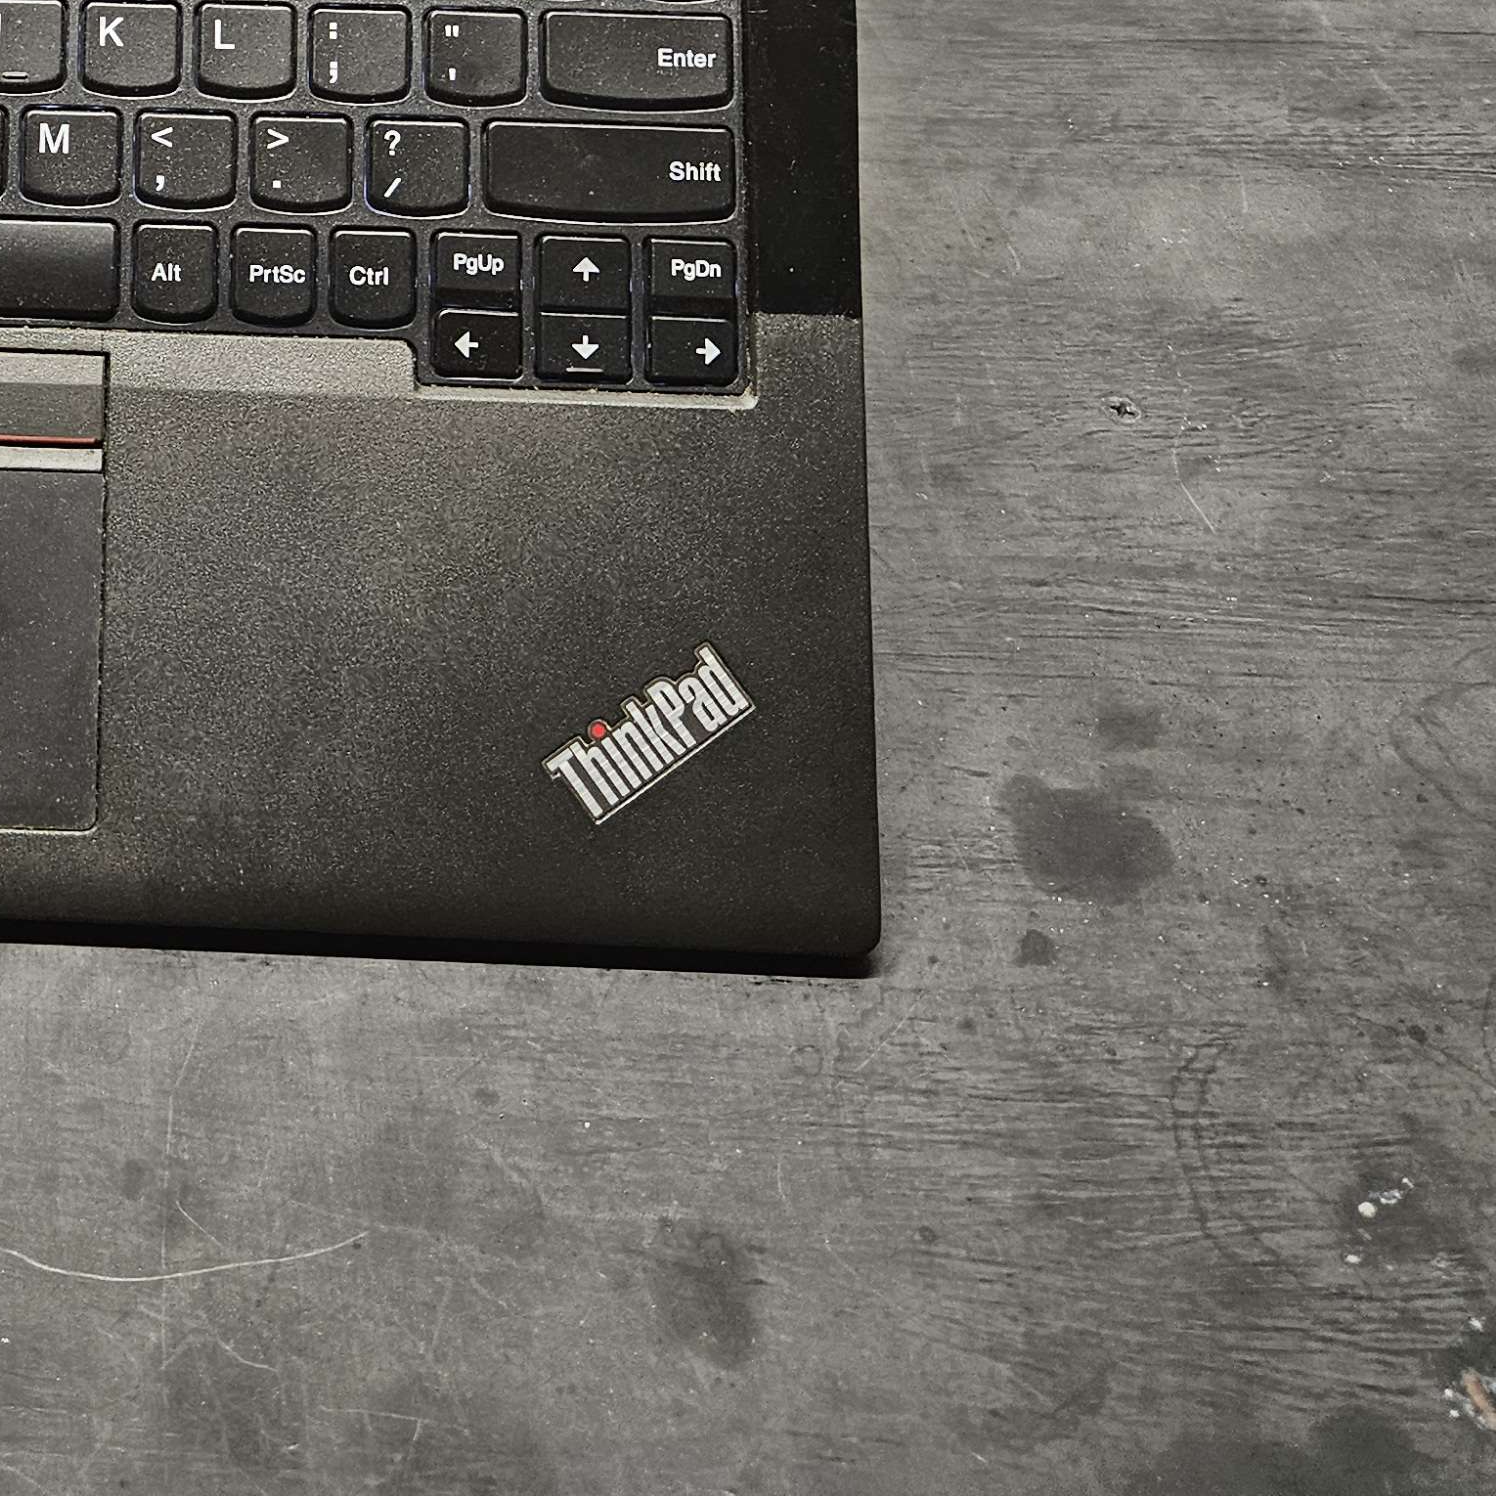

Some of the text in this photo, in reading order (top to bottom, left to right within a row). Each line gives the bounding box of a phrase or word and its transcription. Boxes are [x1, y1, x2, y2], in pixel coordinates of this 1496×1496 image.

[99, 16, 124, 47] K
[214, 19, 236, 50] L
[657, 47, 717, 68] Enter
[38, 122, 70, 155] M
[668, 160, 721, 182] Shift
[151, 262, 182, 282] Alt
[249, 264, 306, 284] PrtSc
[349, 265, 389, 286] Ctrl
[453, 252, 505, 276] PgUp
[671, 258, 722, 282] PgDn
[543, 642, 753, 820] ThinkPad
